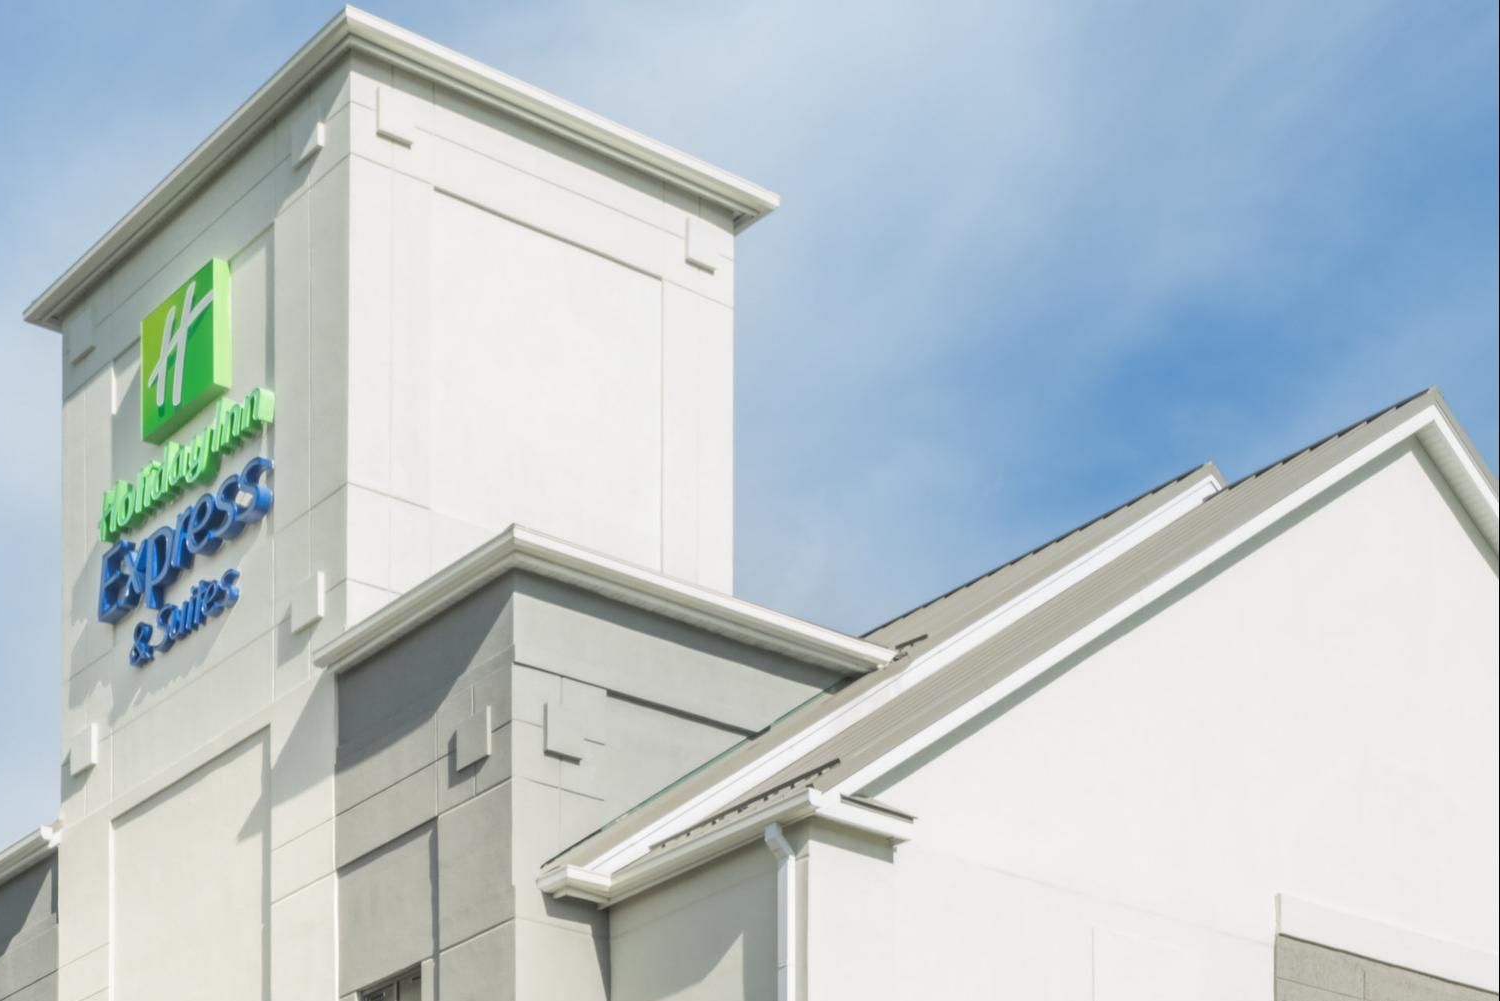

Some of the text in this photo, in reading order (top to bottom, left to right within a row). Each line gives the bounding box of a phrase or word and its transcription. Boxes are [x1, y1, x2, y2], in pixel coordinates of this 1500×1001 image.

[98, 456, 274, 623] Express
[99, 387, 275, 543] Holiday Inn
[129, 568, 241, 668] & Suites
